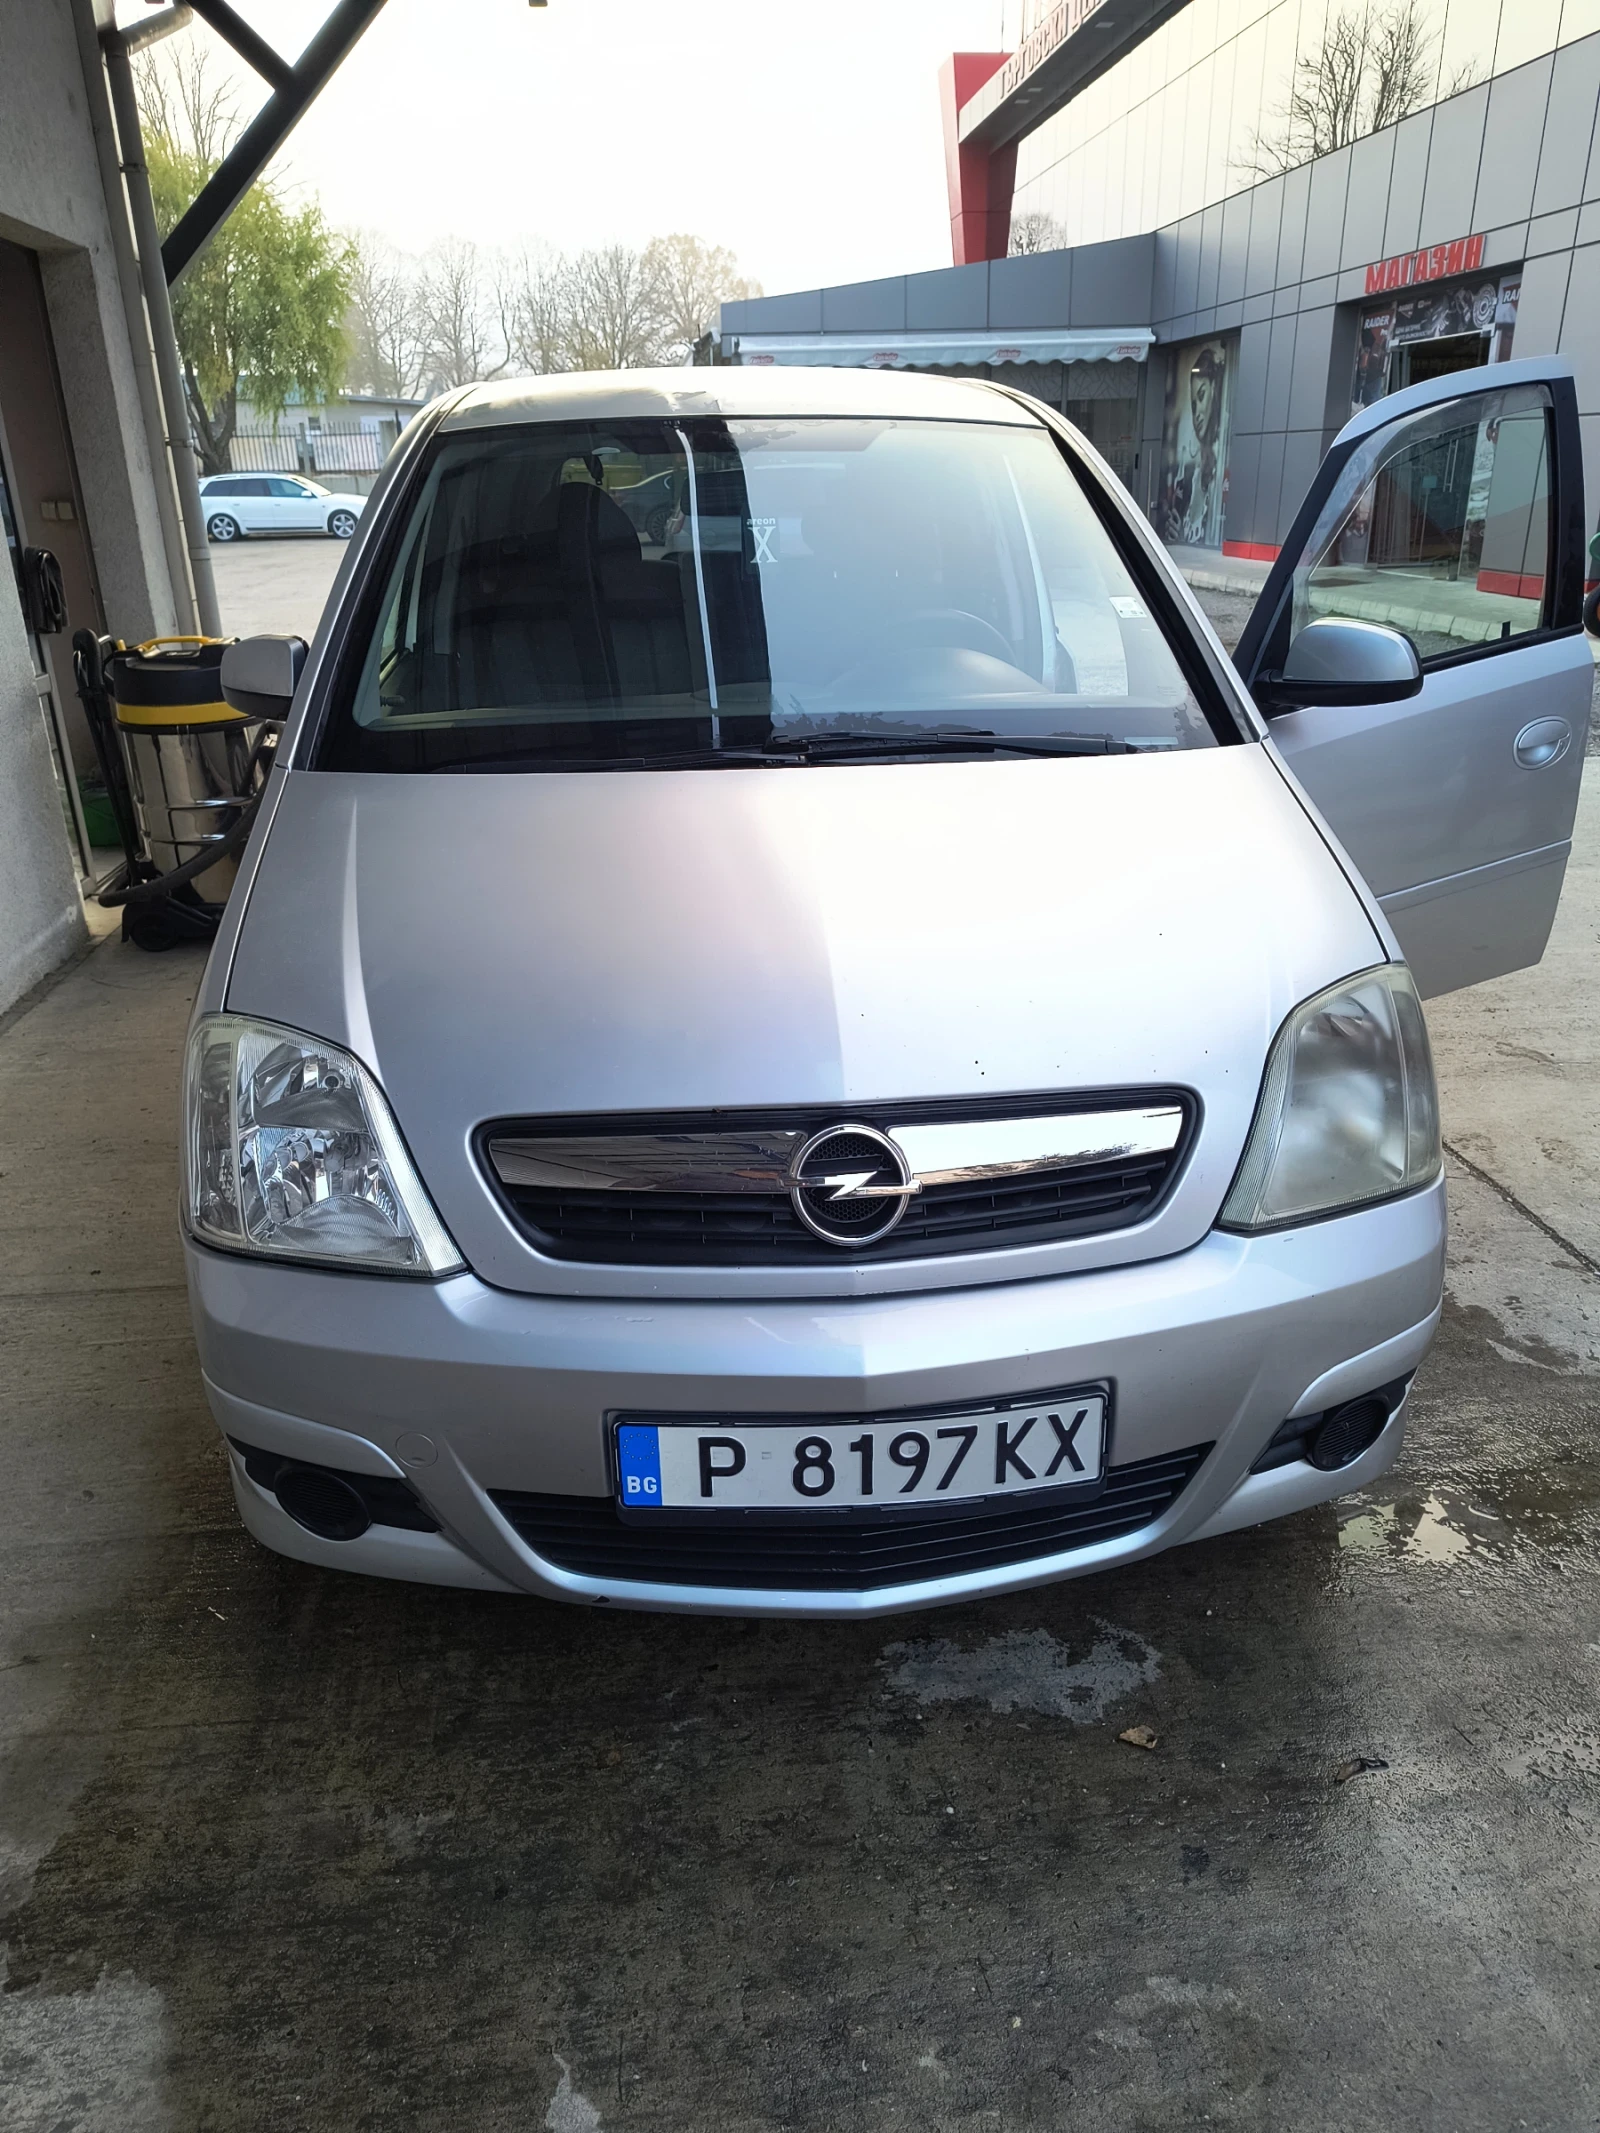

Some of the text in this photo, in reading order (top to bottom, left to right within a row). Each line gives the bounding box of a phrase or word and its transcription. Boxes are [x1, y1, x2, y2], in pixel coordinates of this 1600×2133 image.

[1365, 234, 1486, 294] МАГАЗИН
[1504, 289, 1521, 303] RAI
[1364, 315, 1390, 329] RAIDER
[747, 526, 778, 563] X
[697, 1409, 1090, 1498] P 8197 KX
[627, 1475, 657, 1495] BG
